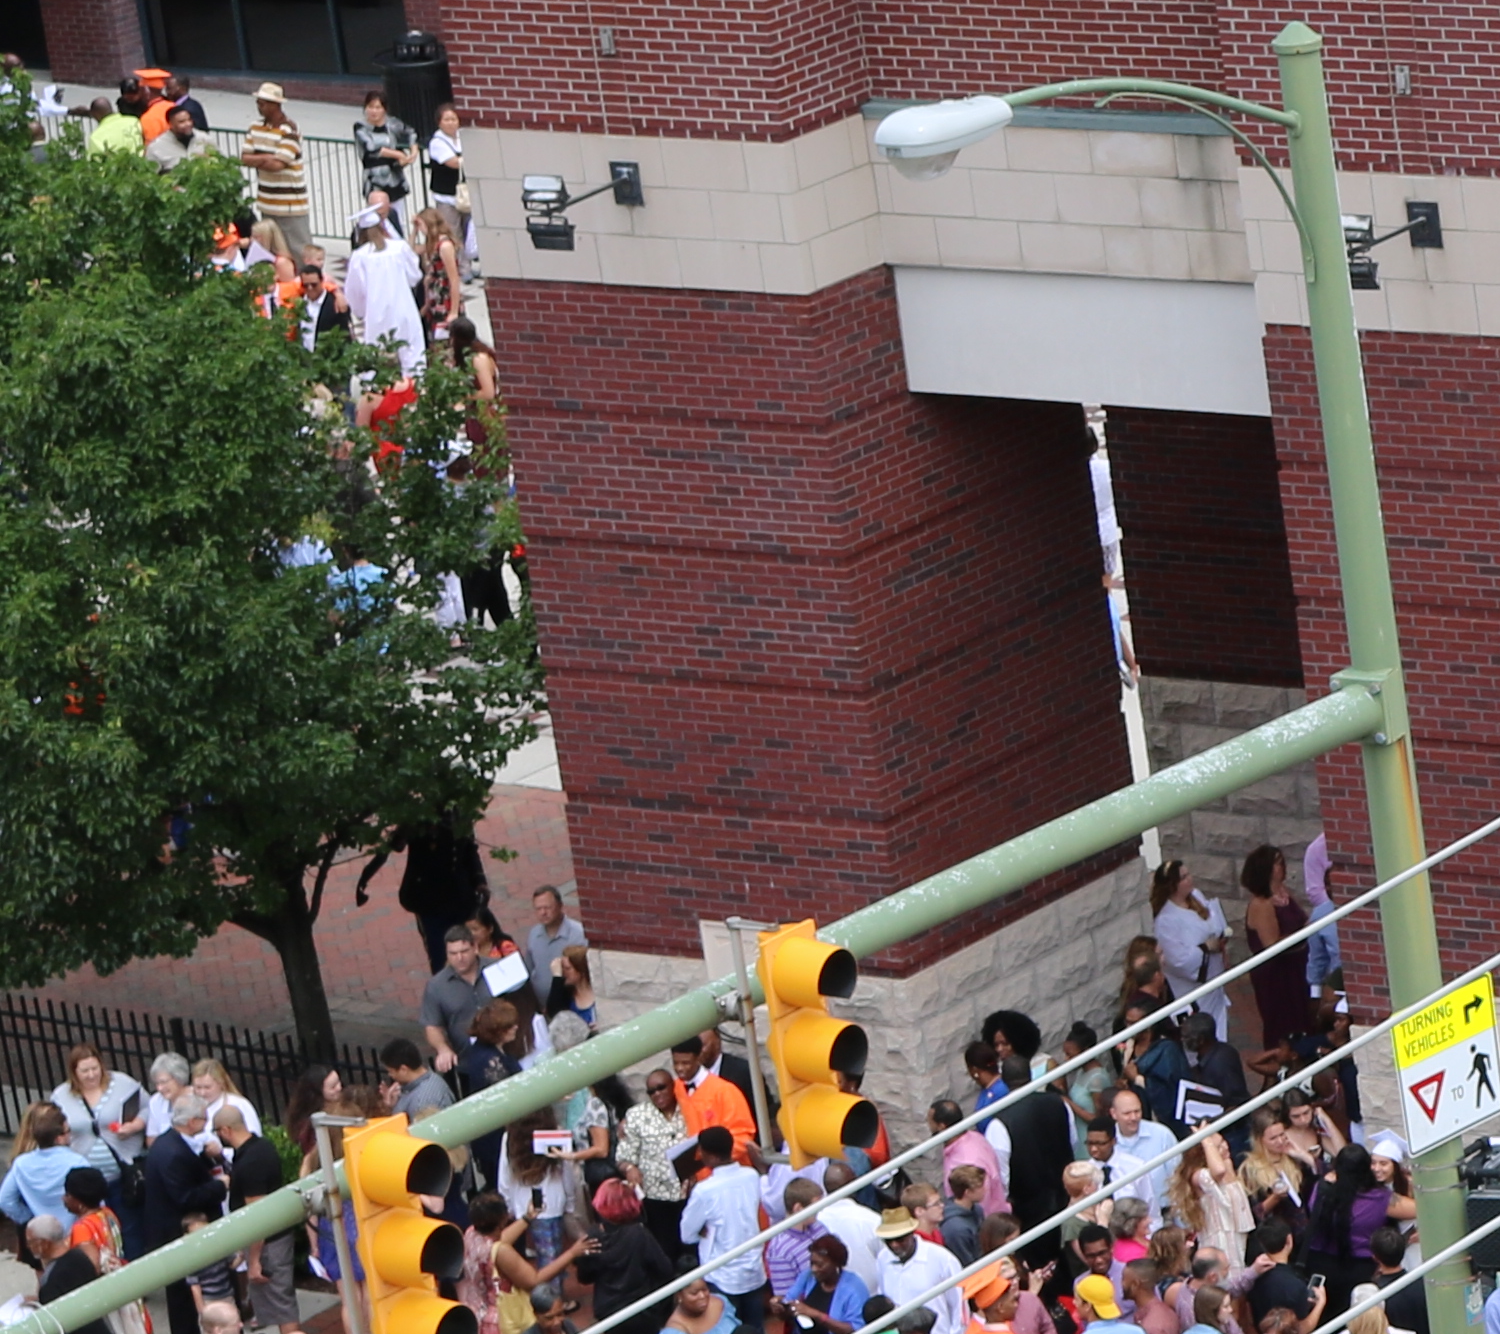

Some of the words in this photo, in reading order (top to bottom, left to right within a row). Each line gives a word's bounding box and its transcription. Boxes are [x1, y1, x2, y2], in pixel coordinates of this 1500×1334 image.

[1400, 1001, 1454, 1039] TURNING
[1403, 1023, 1456, 1060] VEHICLES
[1450, 1086, 1465, 1101] TO
